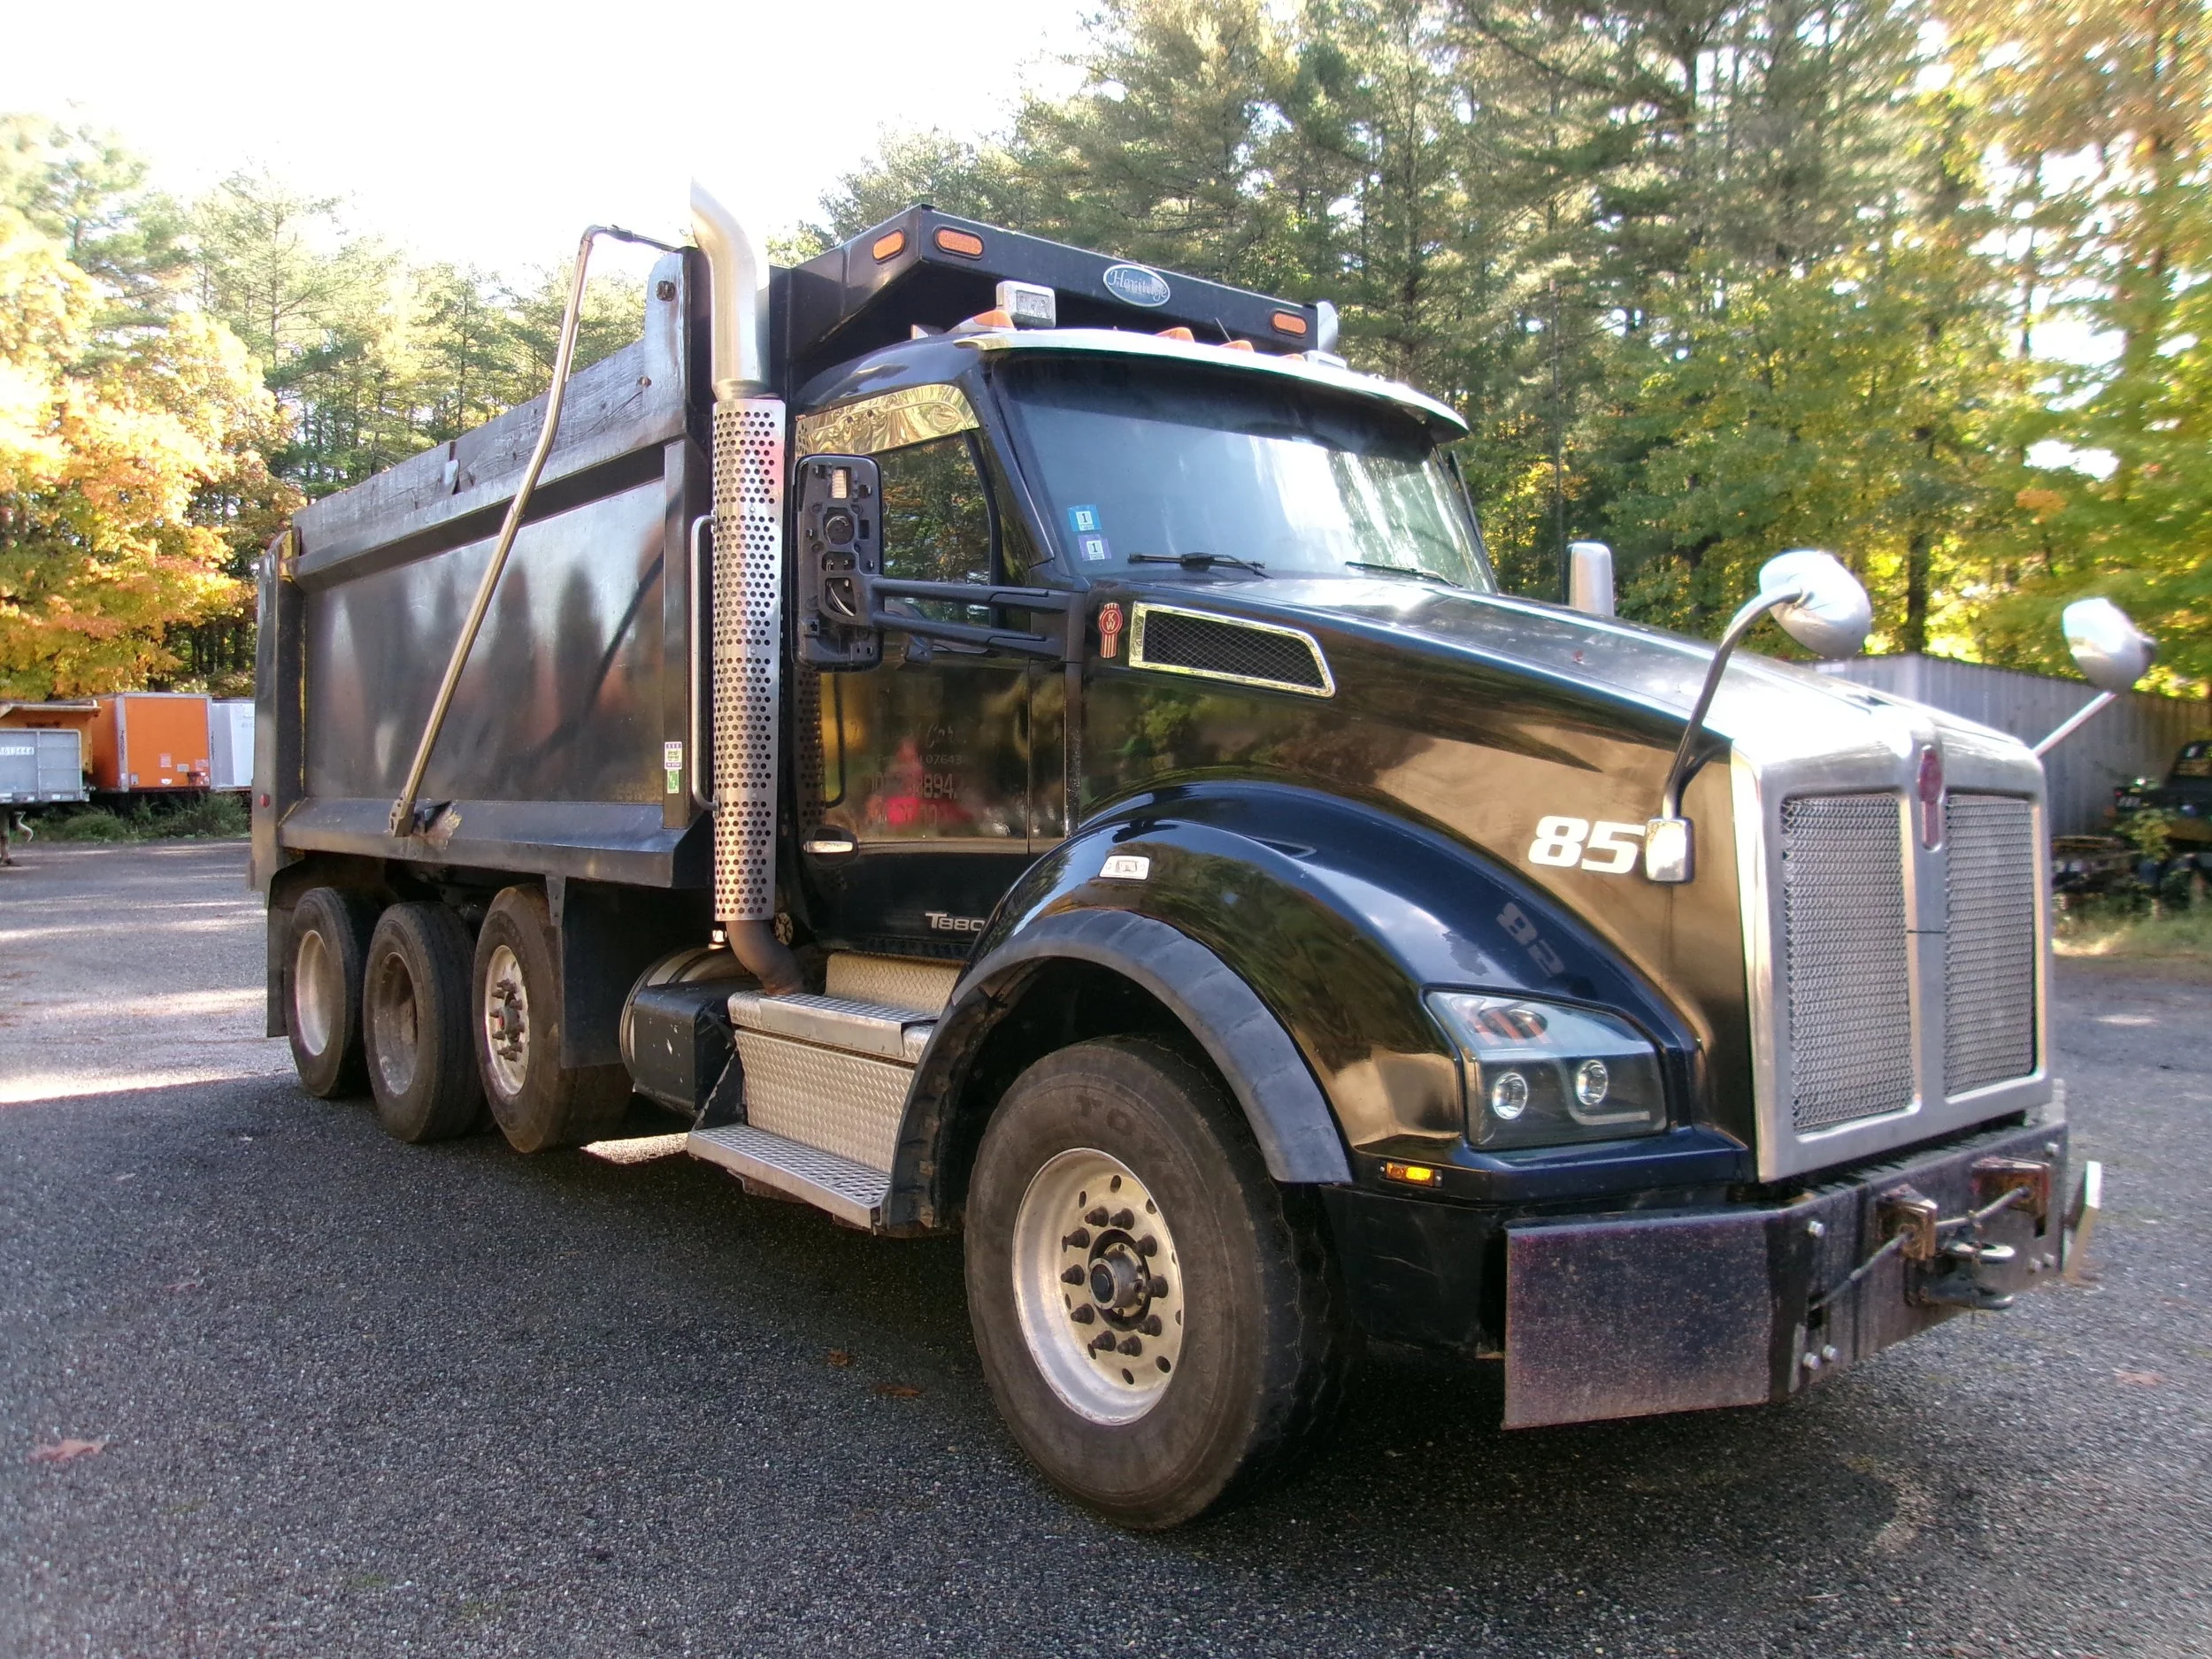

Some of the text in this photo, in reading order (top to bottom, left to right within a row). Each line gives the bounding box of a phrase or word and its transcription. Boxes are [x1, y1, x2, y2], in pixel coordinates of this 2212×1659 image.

[1108, 269, 1167, 303] Heritage
[1528, 815, 1646, 874] 85
[925, 911, 986, 932] T880
